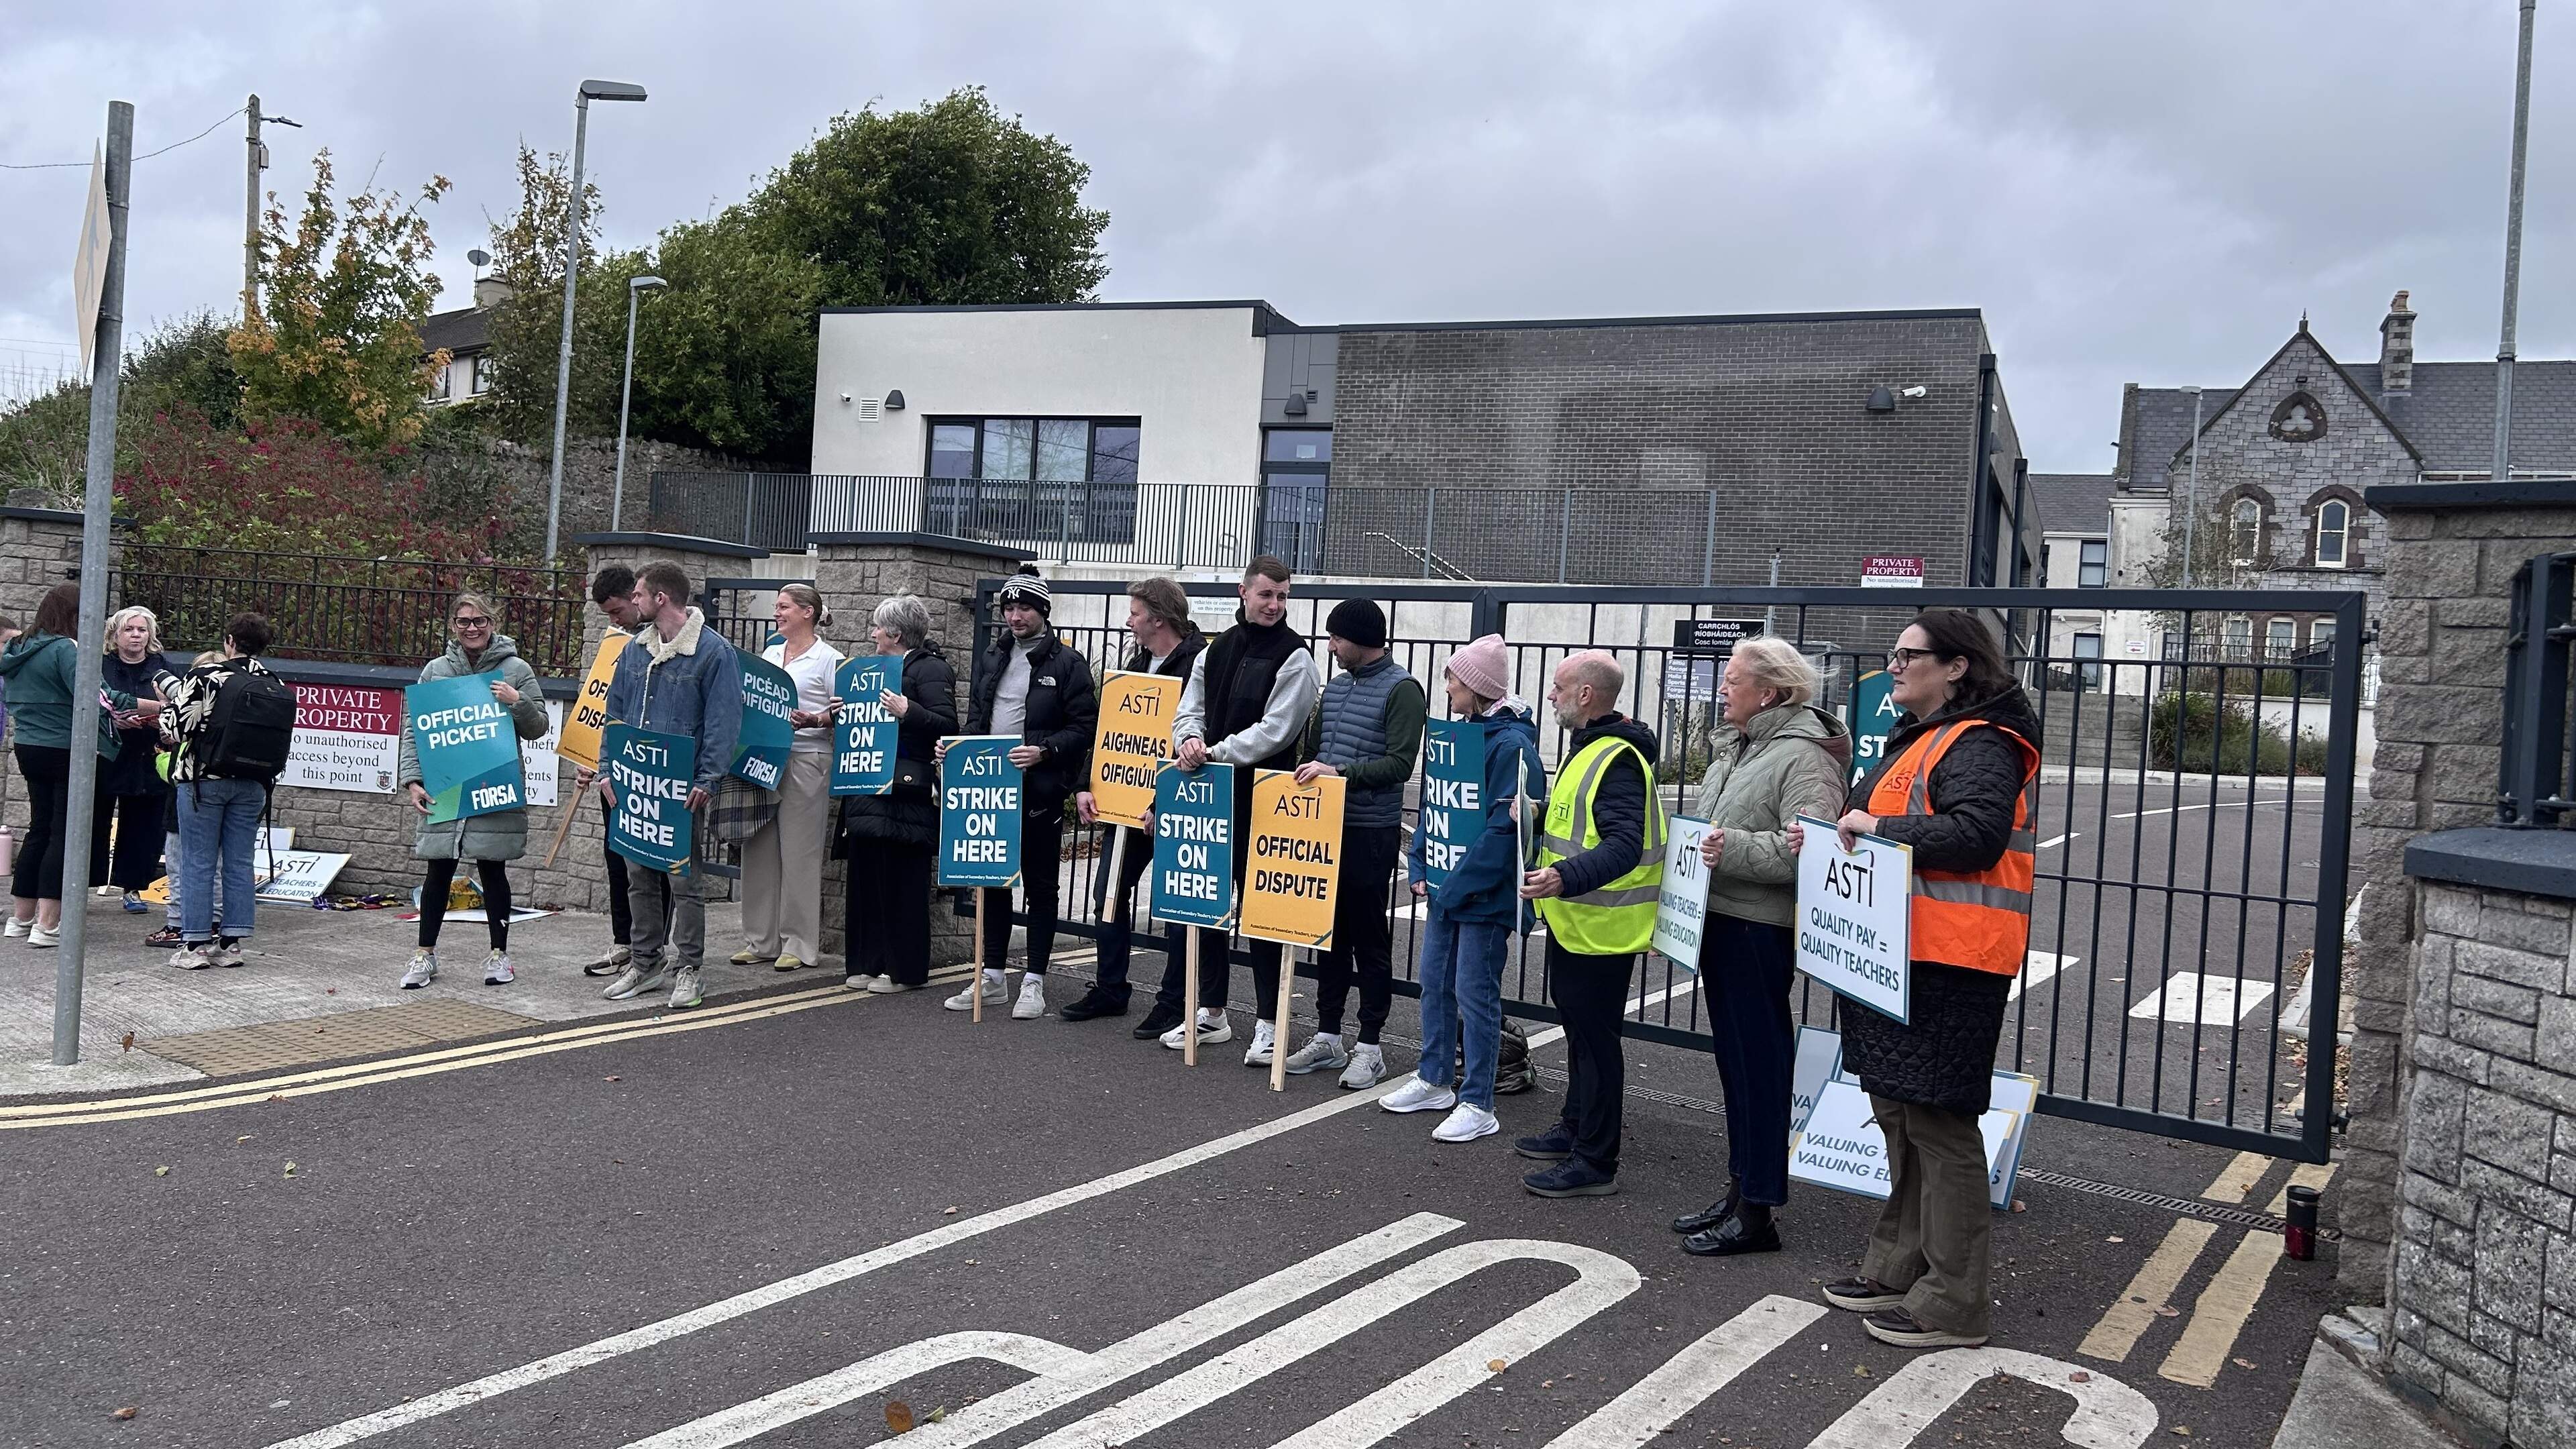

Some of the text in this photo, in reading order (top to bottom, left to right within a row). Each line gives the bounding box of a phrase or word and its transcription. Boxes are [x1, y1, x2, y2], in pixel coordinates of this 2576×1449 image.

[1866, 567, 1919, 576] PROPERTY
[1872, 558, 1915, 567] PRIVATE
[1694, 630, 1747, 638] RÍOBHÁIDEACH
[743, 672, 790, 702] PICÉAD
[849, 672, 884, 692] ASTI
[296, 686, 381, 709] PRIVATE
[1119, 692, 1161, 716] ASTI
[294, 707, 392, 731] ROPERTY
[417, 702, 507, 731] OFFICIAL
[577, 705, 606, 730] DISP
[837, 701, 896, 725] STRIKE
[294, 735, 388, 751] o unauthorised
[428, 722, 499, 749] PICKET
[527, 739, 555, 751] theft
[849, 727, 875, 749] ON
[1101, 731, 1167, 759] AIGHNEAS
[288, 751, 380, 768] access beyond
[623, 739, 667, 767] ASTI
[839, 751, 883, 773] HERE
[961, 756, 1002, 775] ASTI
[303, 767, 363, 784] this point
[612, 759, 688, 802] STRIKE
[1101, 761, 1157, 790] OIFIGIÚIL
[946, 787, 1018, 810] STRIKE
[1175, 780, 1214, 805] ASTI
[1426, 773, 1480, 810] RIKE
[627, 793, 660, 821] ON
[1274, 794, 1322, 820] ASTI
[619, 808, 674, 847] HERE
[965, 813, 997, 837] ON
[1159, 812, 1229, 844] STRIKE
[1426, 806, 1449, 839] ON
[953, 839, 1007, 863] HERE
[1177, 843, 1208, 870] ON
[1256, 834, 1334, 865] OFFICIAL
[1426, 837, 1466, 871] ERE
[1674, 843, 1698, 879] ASTI
[268, 888, 318, 898] EDUCATION
[274, 878, 318, 888] TEACHERS
[1165, 871, 1218, 901] HERE
[1254, 869, 1328, 901] DISPUTE
[1823, 857, 1874, 908] ASTI
[1811, 906, 1888, 953] QUALITY PAY =
[1801, 931, 1899, 991] QUALITY TEACHERS
[1807, 1132, 1879, 1157] VALUING
[1798, 1150, 1871, 1177] VALUING
